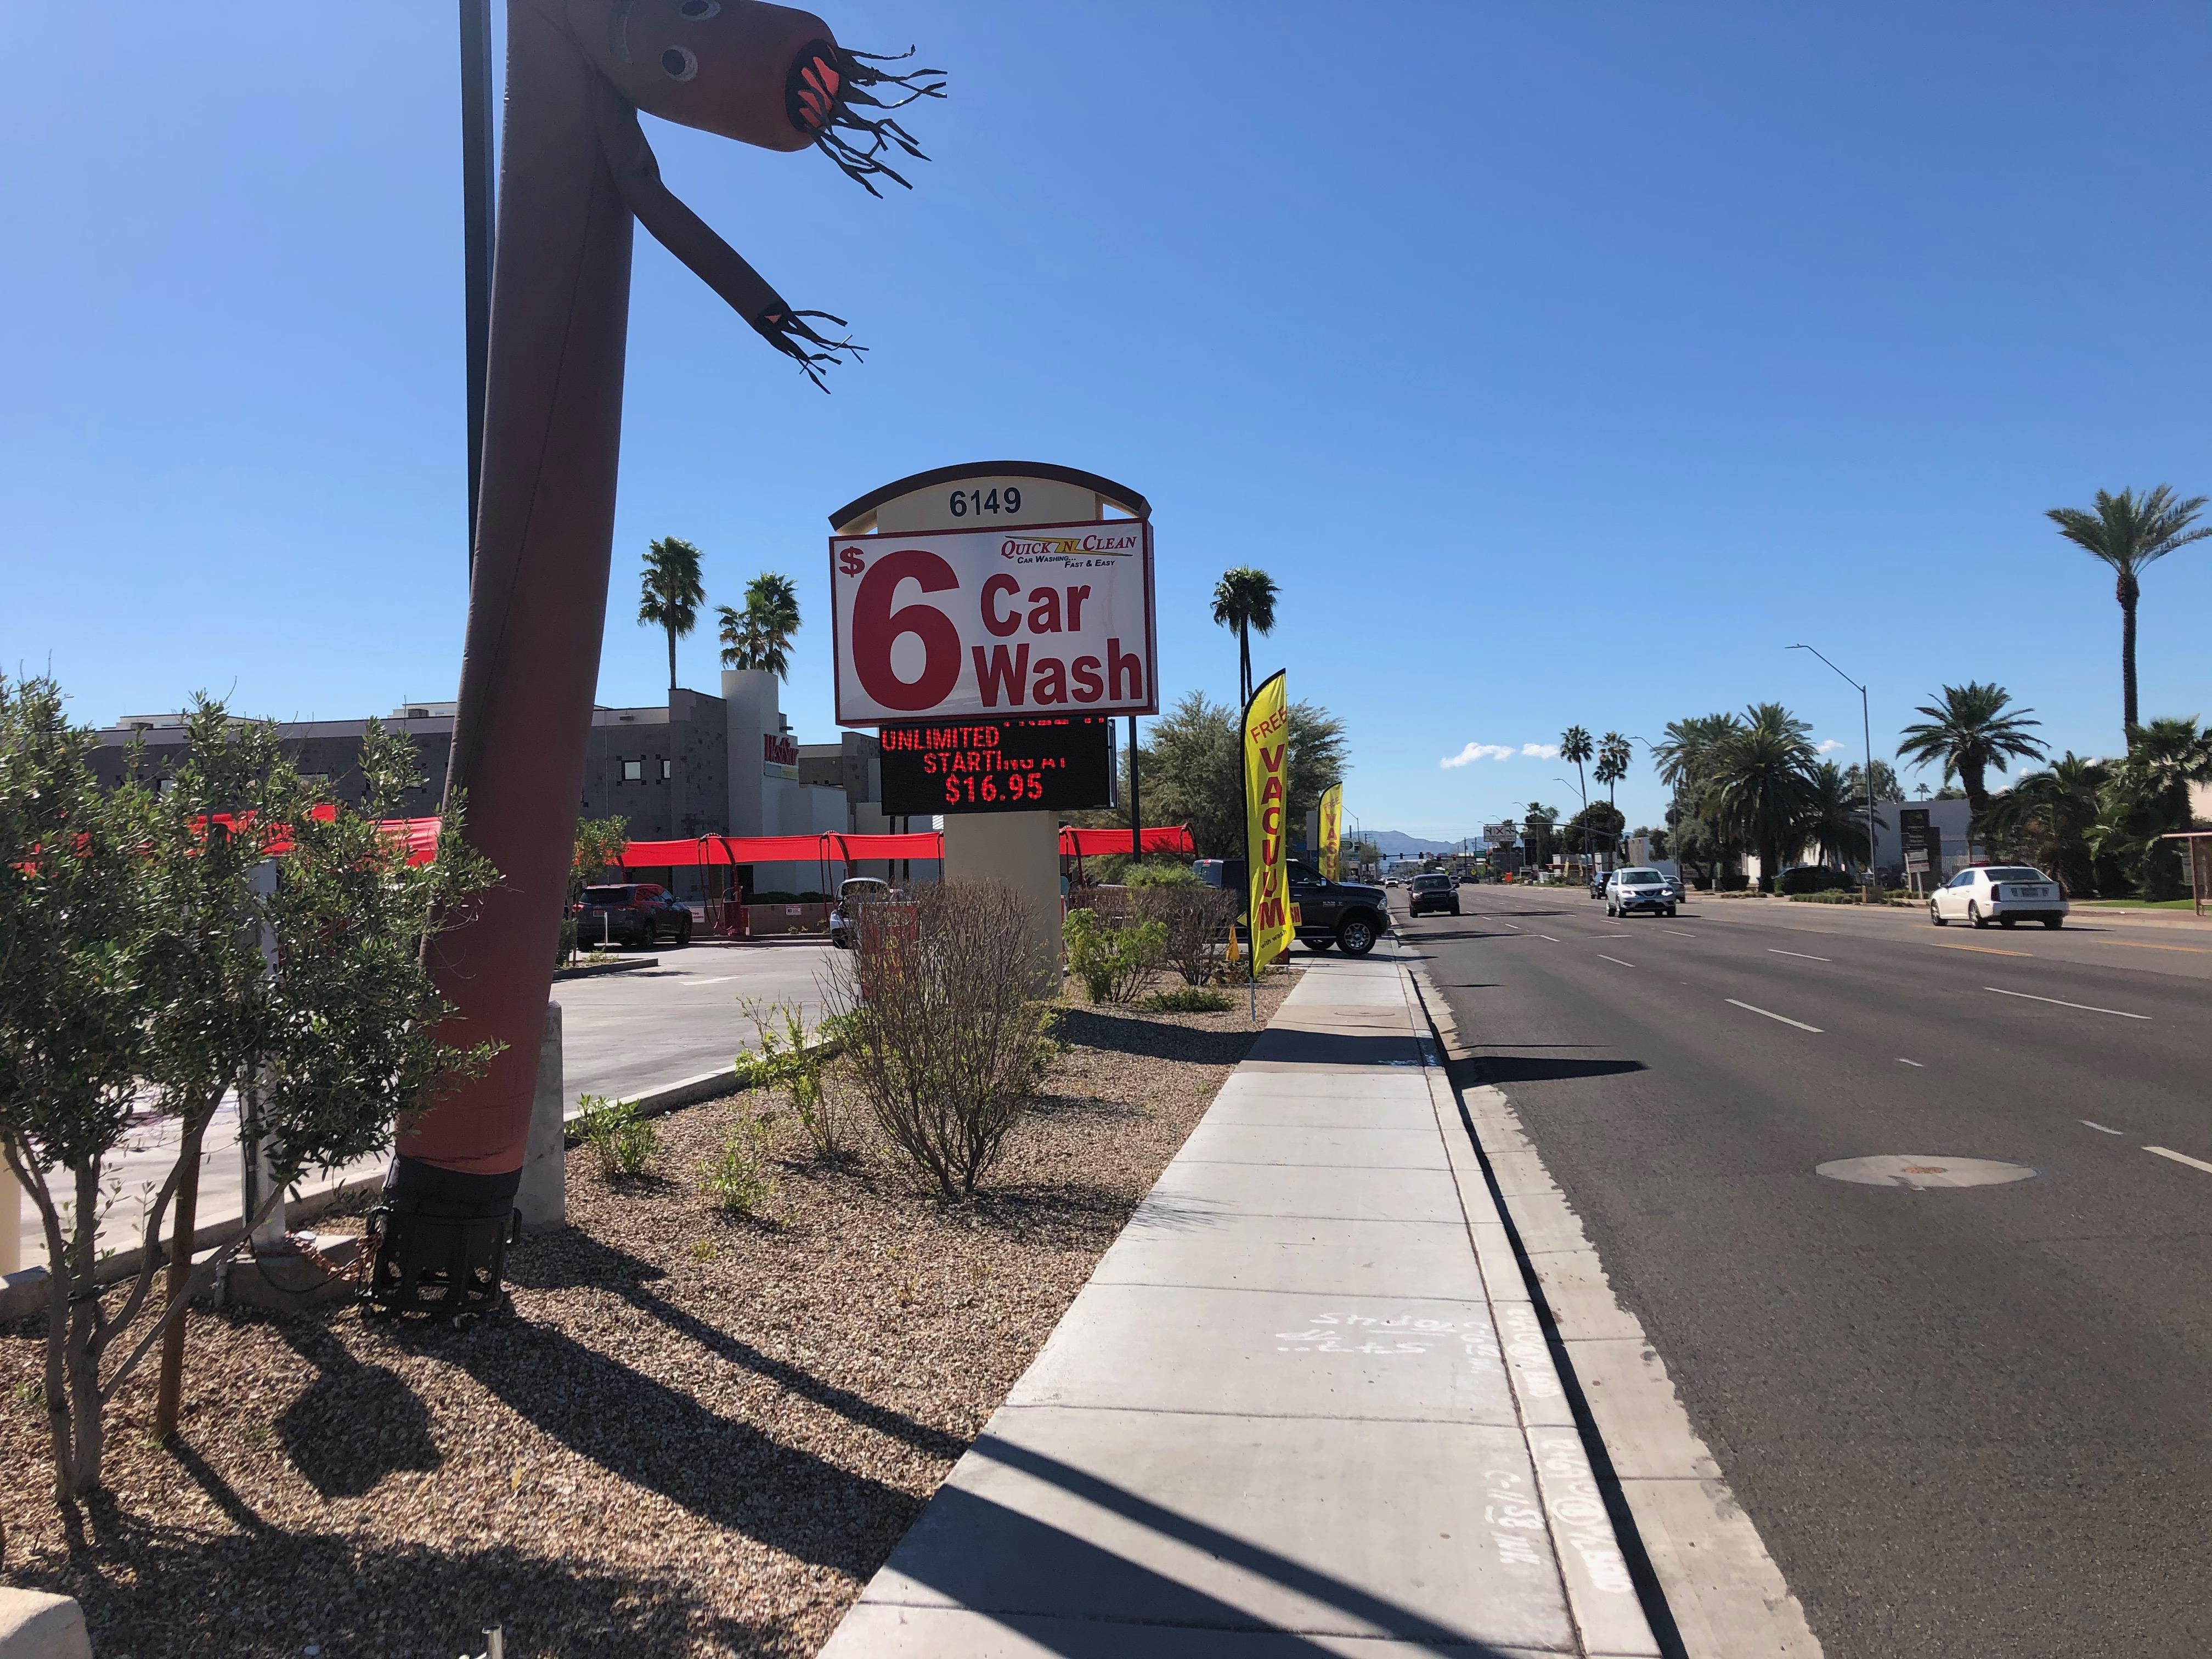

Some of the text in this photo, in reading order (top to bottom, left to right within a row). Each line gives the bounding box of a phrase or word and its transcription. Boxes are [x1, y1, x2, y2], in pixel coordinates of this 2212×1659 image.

[949, 487, 1022, 517] 6149
[1001, 535, 1137, 560] QUICK N CLEAN
[980, 573, 1091, 637] Car
[972, 638, 1143, 708] Wash
[882, 725, 1000, 751] UNLIMITED
[1250, 705, 1287, 744] FREE
[945, 772, 1043, 806] $16.95
[1323, 796, 1341, 809] FREE
[1259, 743, 1286, 931] VACUUM
[1261, 929, 1287, 949] with wash
